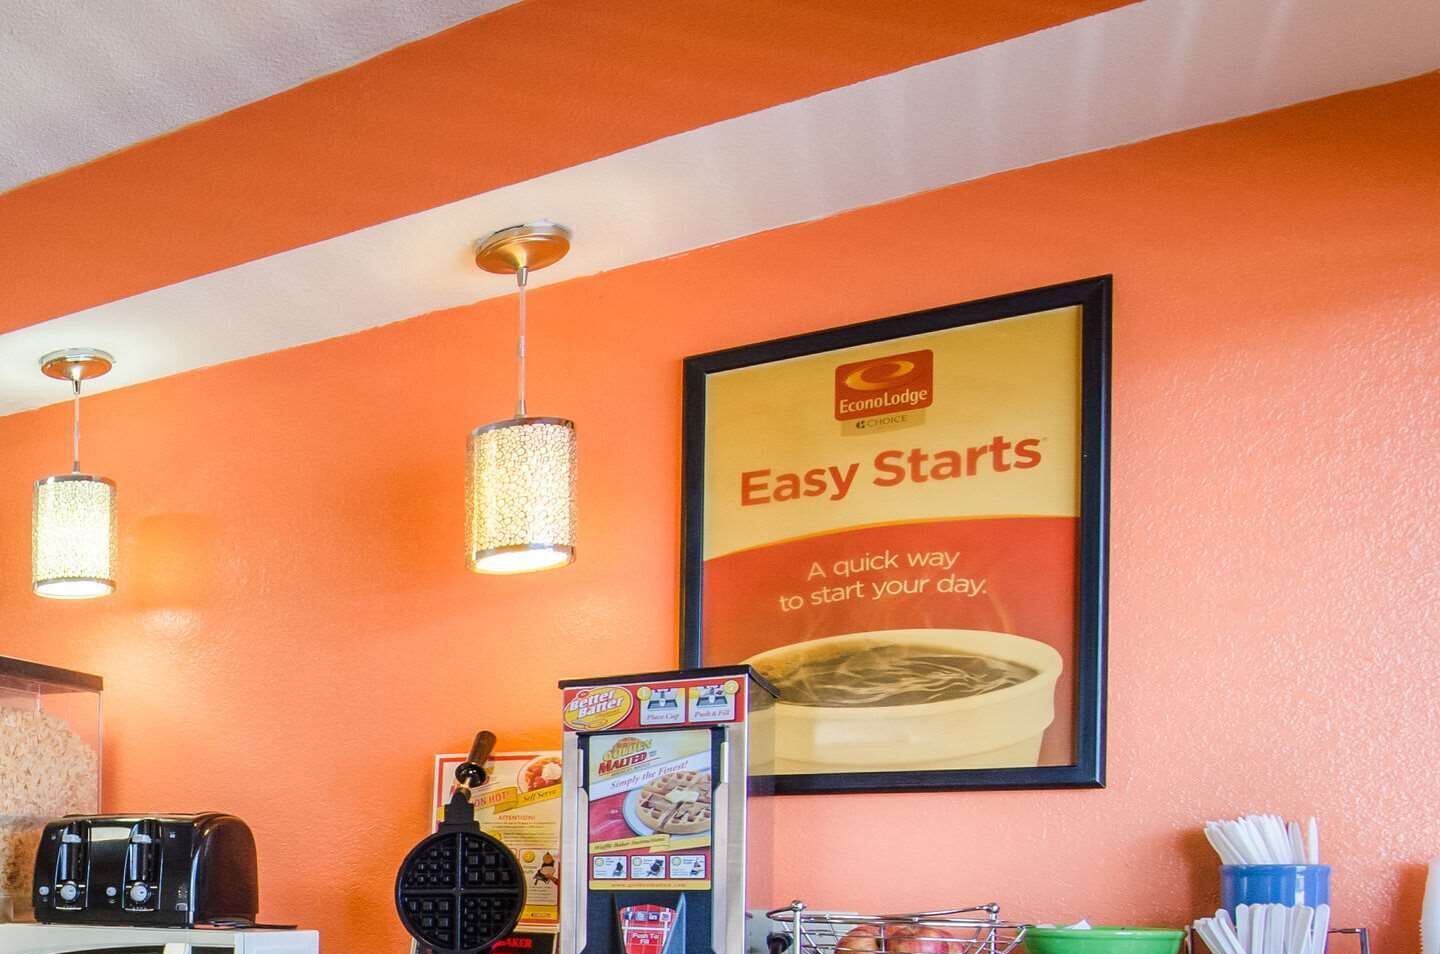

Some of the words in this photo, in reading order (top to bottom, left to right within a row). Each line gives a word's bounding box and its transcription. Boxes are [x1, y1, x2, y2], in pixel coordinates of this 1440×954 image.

[840, 388, 928, 414] EconoLodge
[867, 415, 907, 428] CHOICE
[740, 462, 859, 507] Easy
[872, 435, 1042, 488] Starts
[807, 561, 827, 581] A
[833, 549, 899, 577] quick
[907, 550, 961, 570] way
[779, 594, 804, 612] to
[810, 580, 865, 605] start
[871, 577, 930, 600] your
[936, 573, 988, 598] day.
[598, 751, 648, 774] MALTED
